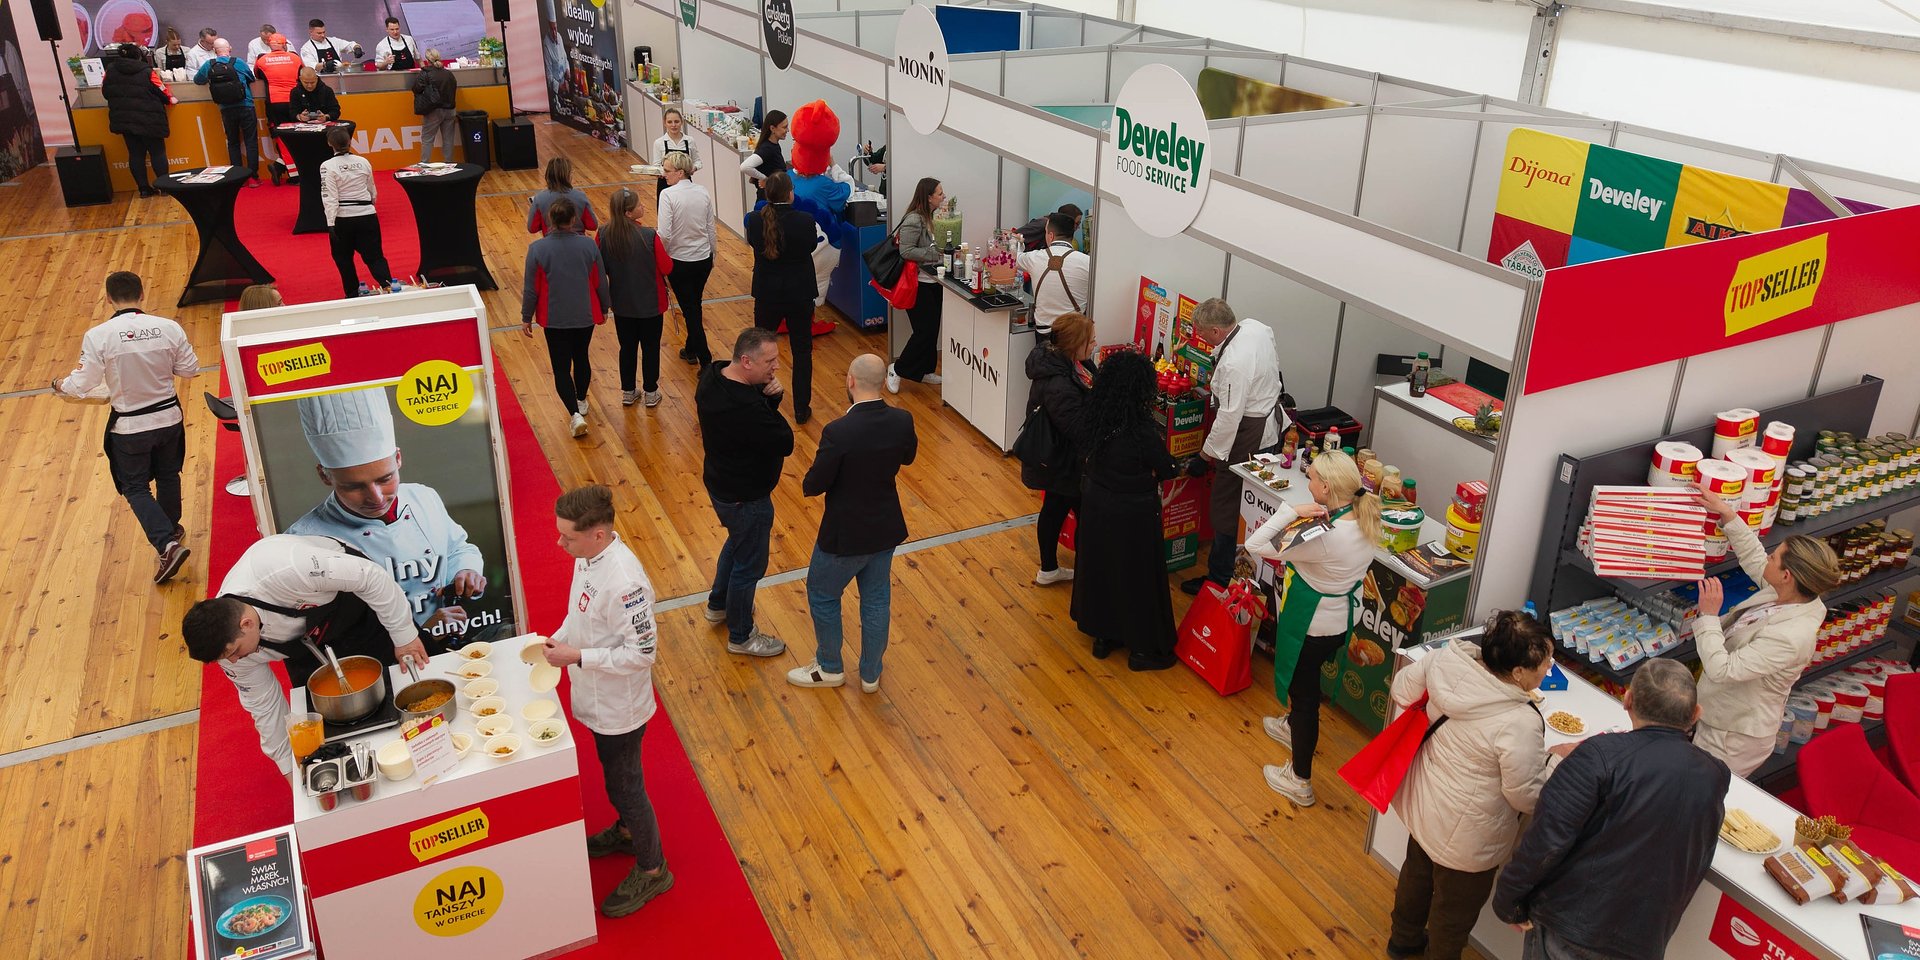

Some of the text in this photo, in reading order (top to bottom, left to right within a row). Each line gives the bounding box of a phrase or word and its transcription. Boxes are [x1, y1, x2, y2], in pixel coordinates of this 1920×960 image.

[565, 2, 595, 27] Idealny
[765, 0, 790, 29] Carlsberg
[567, 28, 594, 47] wybór
[777, 29, 792, 46] Polska
[899, 52, 944, 87] MONIN
[1116, 106, 1205, 189] Develey
[1116, 155, 1187, 194] FOOD SERVICE
[1508, 156, 1571, 189] Dijona
[1589, 177, 1663, 222] Develey
[1691, 221, 1745, 240] AIK
[1507, 259, 1543, 277] TABASCO
[1731, 258, 1820, 313] TOPSELLER
[119, 327, 161, 340] POLAND
[260, 352, 327, 377] TOPSELLER
[950, 337, 998, 387] MONIN
[415, 372, 458, 395] NAJ
[406, 391, 450, 406] TAŃSZY
[416, 402, 459, 416] W OFERCIE
[1174, 413, 1203, 427] Develey
[412, 818, 485, 853] TOPSELLER
[250, 870, 280, 885] MAREK
[251, 862, 277, 877] ŚWIAT
[242, 876, 289, 895] WŁASNYCH
[436, 877, 486, 906] NAJ
[424, 898, 476, 920] TAŃSZY
[435, 908, 486, 928] W OFERCIE
